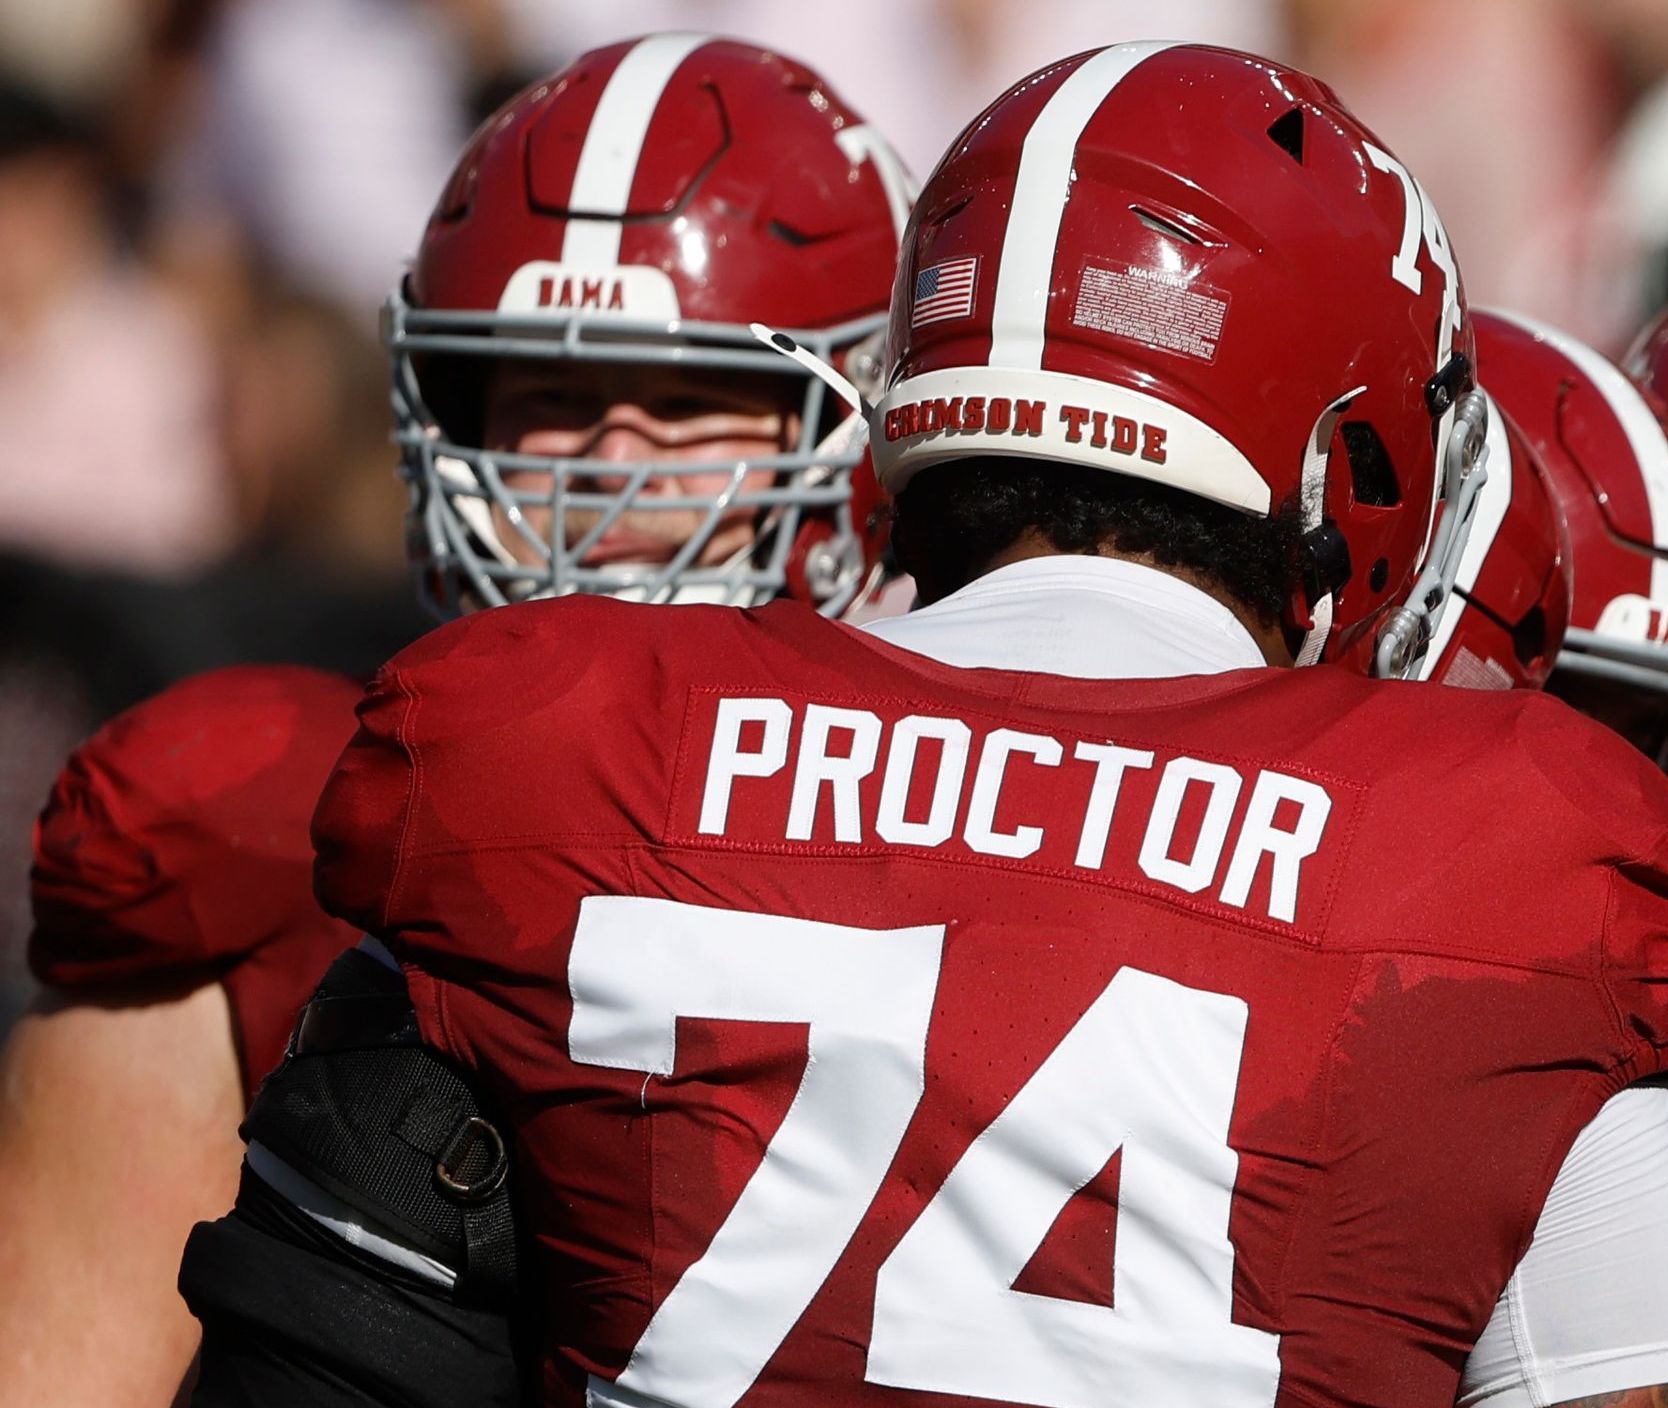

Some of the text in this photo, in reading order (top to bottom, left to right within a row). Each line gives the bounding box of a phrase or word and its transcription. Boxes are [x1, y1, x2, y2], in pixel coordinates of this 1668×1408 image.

[1362, 140, 1462, 331] 74
[538, 277, 624, 309] BAMA
[1128, 265, 1190, 290] WARNING
[885, 397, 1168, 465] CRIMSON TIDE
[697, 697, 1333, 925] PROCTOR
